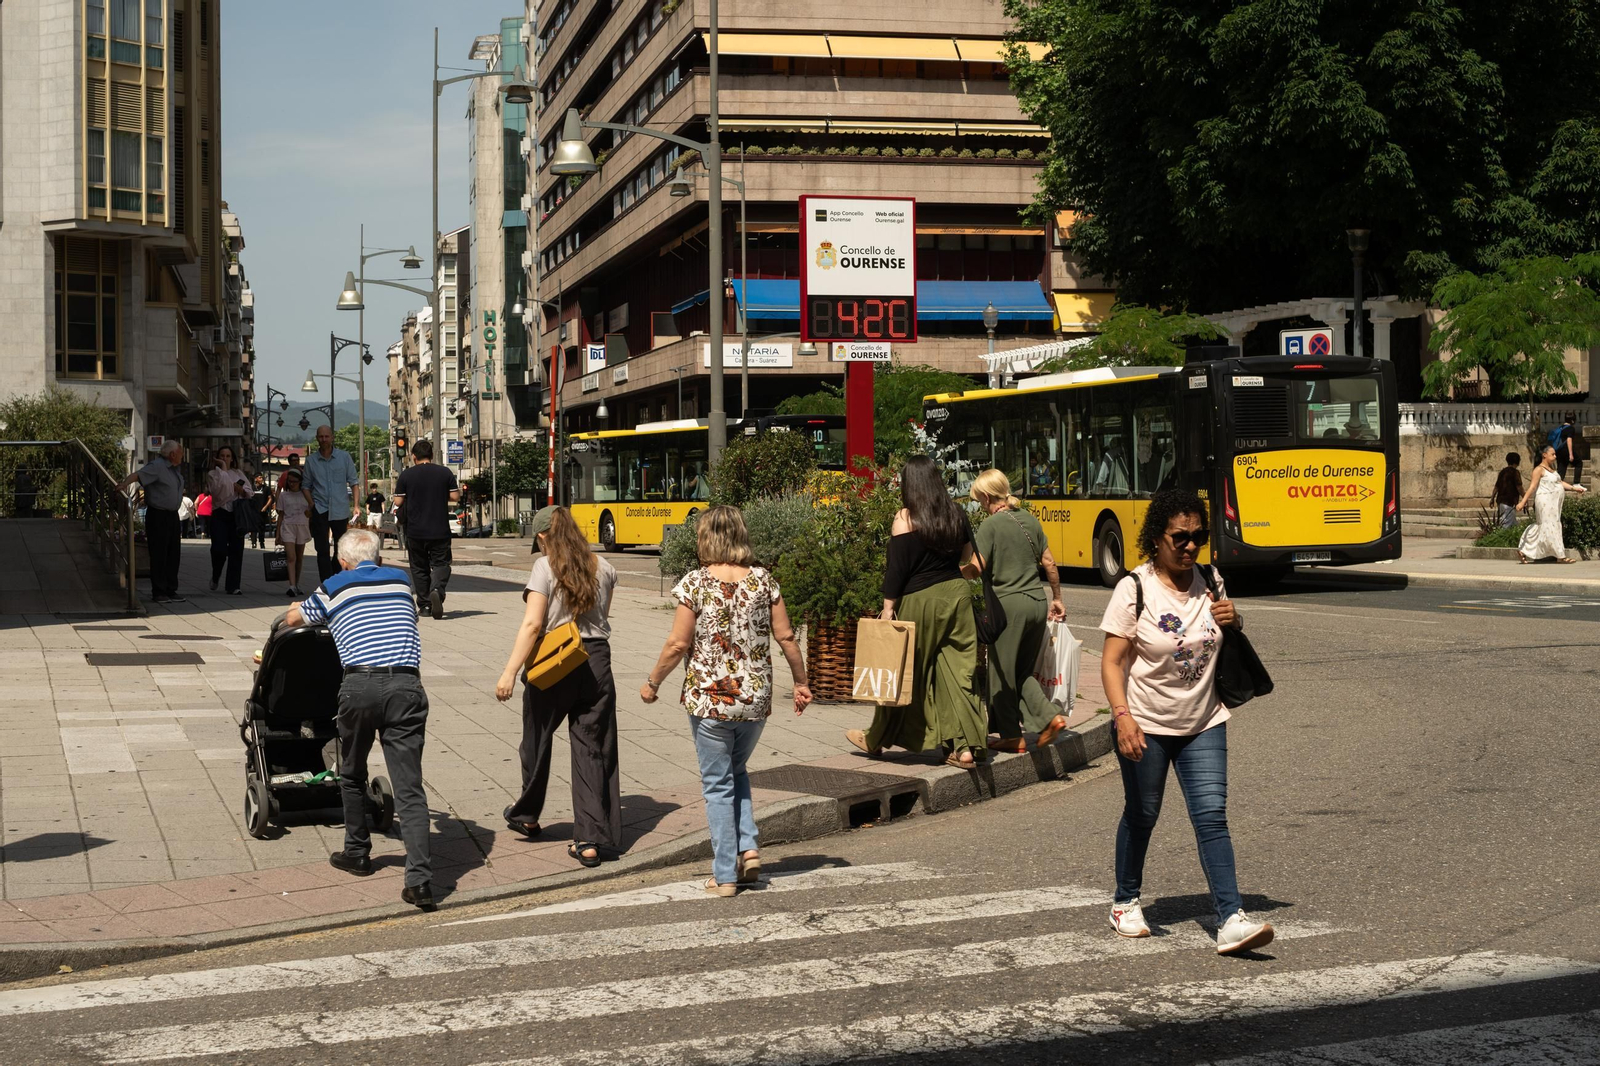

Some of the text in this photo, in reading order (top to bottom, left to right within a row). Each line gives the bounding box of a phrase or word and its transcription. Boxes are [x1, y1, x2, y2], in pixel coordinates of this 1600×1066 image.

[840, 245, 896, 255] Concello de
[840, 257, 905, 269] OURENSE
[850, 351, 888, 359] OURENSE
[1306, 381, 1316, 401] 7
[813, 429, 823, 442] 10
[1236, 456, 1258, 466] 6904
[1245, 465, 1374, 479] Concello de Ourense
[1287, 484, 1358, 498] avanza
[626, 507, 672, 517] Concello de Ourense
[1041, 505, 1071, 523] Ourense
